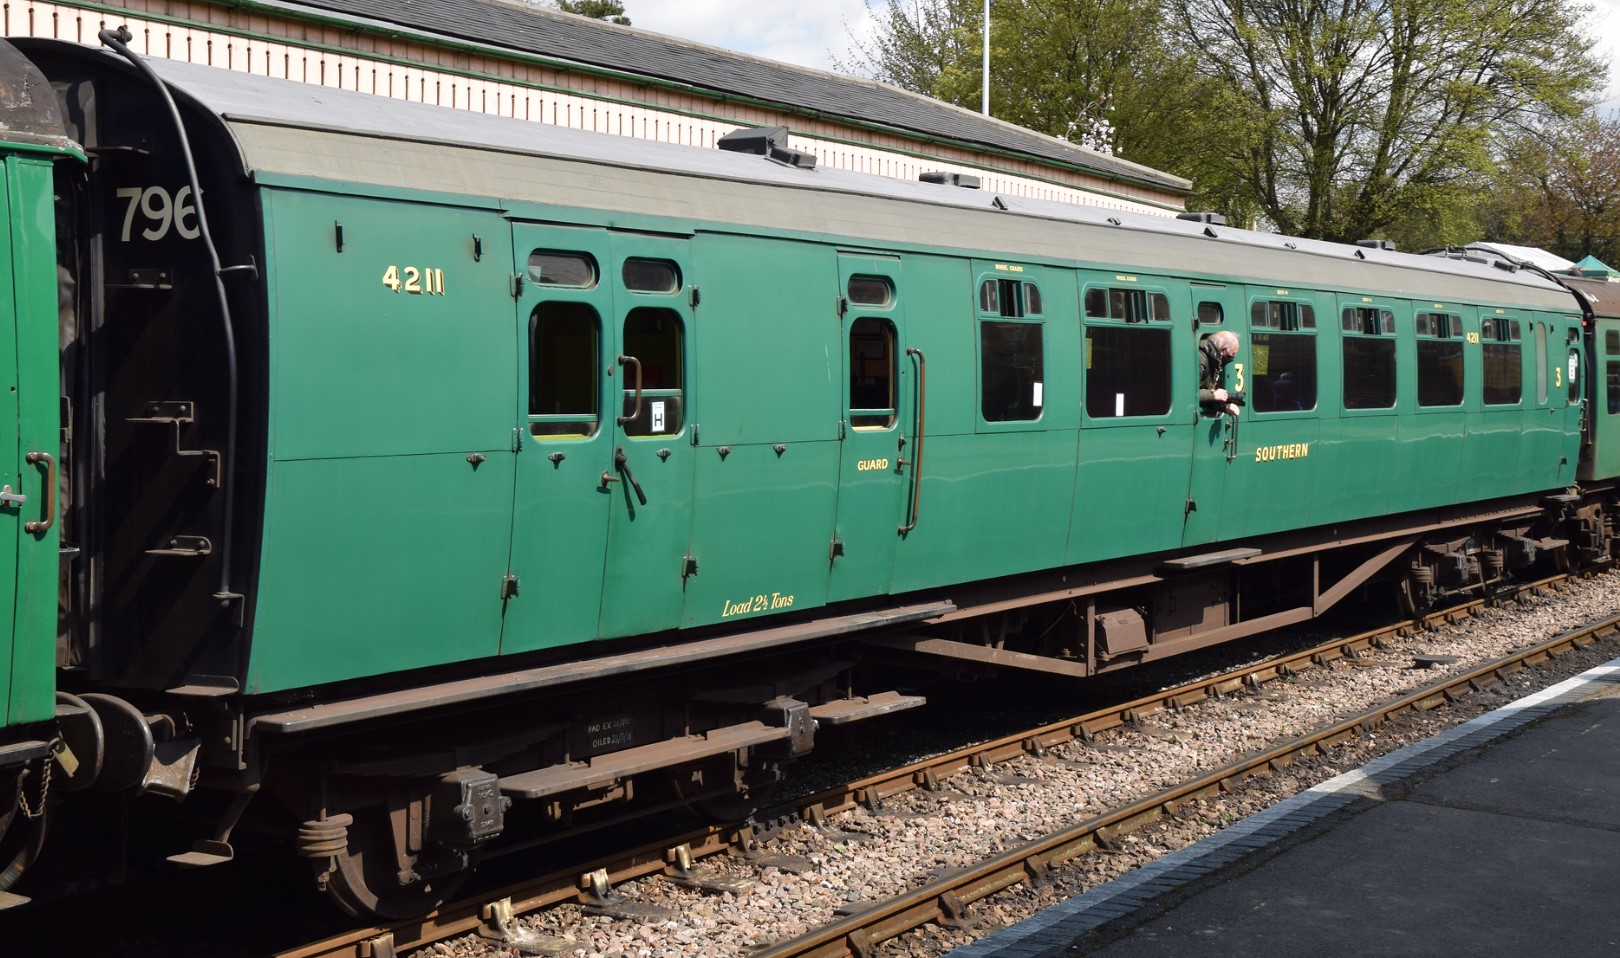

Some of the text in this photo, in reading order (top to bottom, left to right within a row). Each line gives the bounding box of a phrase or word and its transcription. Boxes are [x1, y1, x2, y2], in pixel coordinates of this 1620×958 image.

[116, 185, 204, 242] 796
[382, 265, 445, 296] 4211
[1466, 332, 1479, 344] 4211
[1234, 363, 1245, 392] 3
[1555, 367, 1561, 388] 3
[654, 413, 663, 427] H
[1255, 443, 1309, 463] SOUTHERN
[857, 458, 889, 471] GUARD
[721, 596, 754, 617] Load
[770, 592, 794, 610] Tons
[592, 736, 611, 748] OILED
